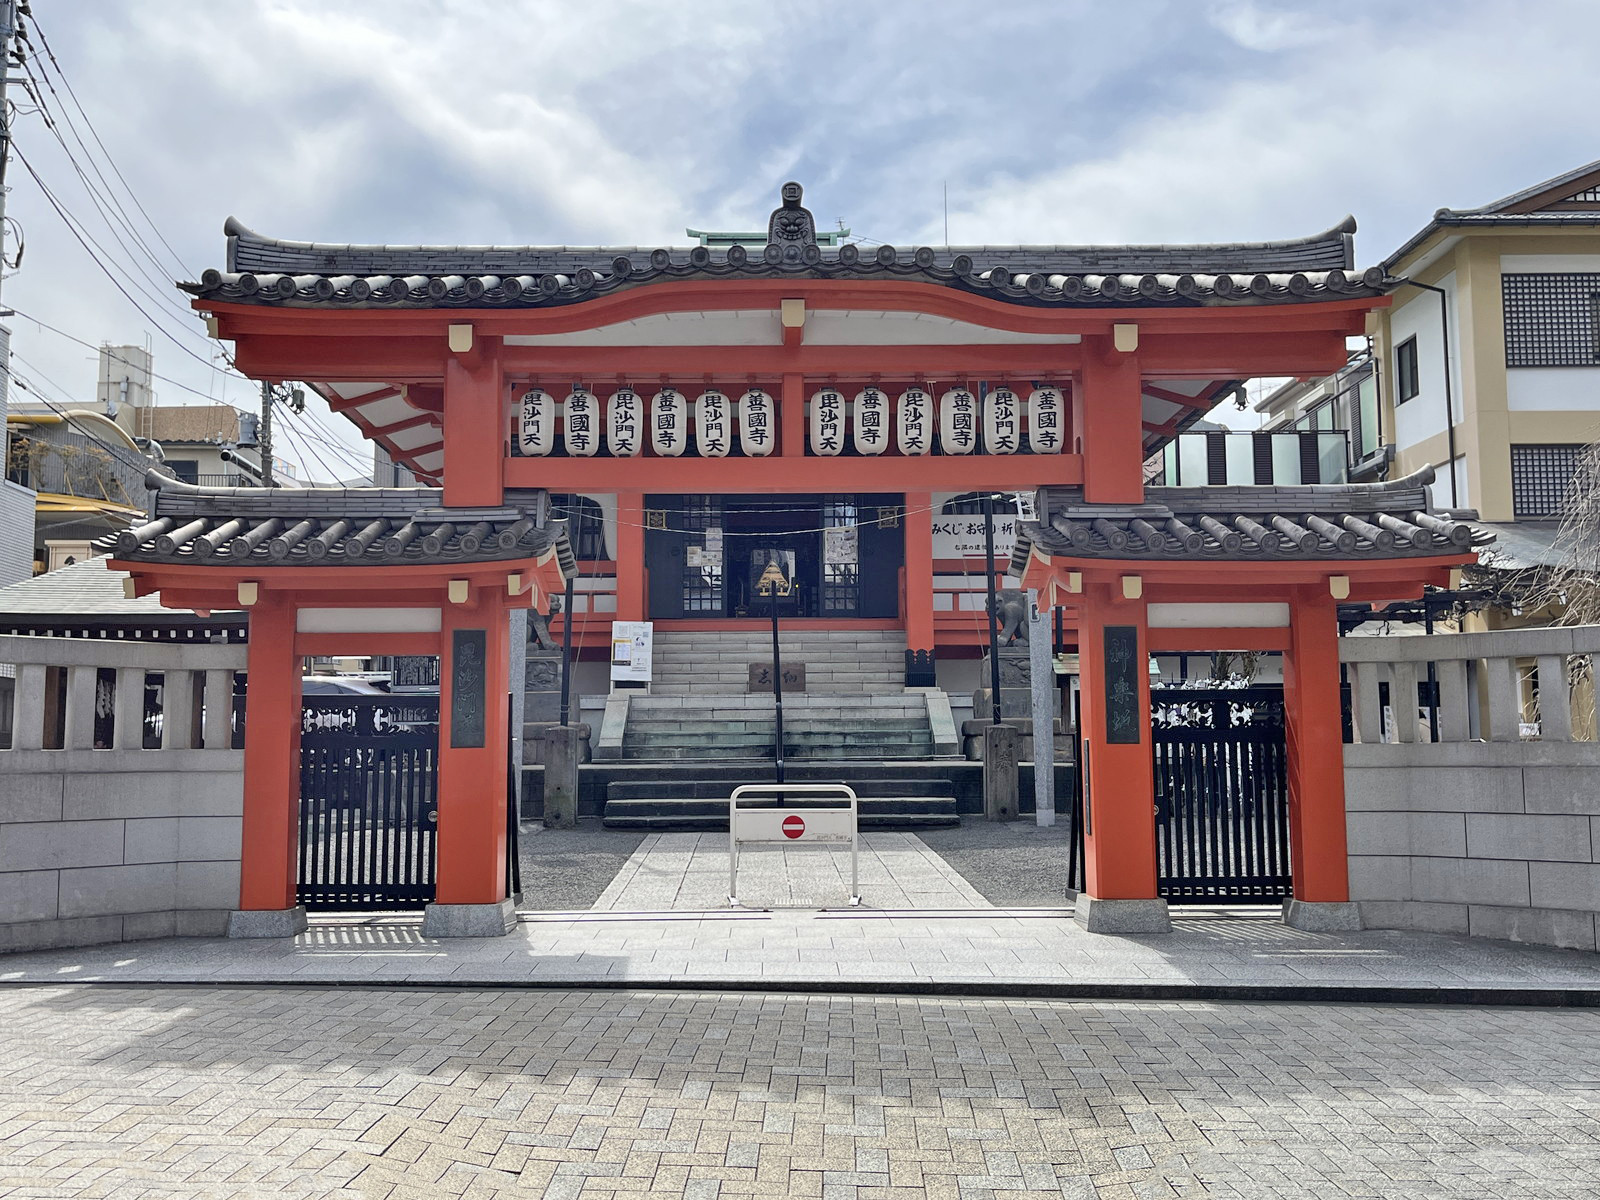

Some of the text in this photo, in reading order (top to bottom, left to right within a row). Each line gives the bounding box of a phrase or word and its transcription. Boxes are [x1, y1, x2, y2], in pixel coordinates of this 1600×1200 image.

[523, 393, 542, 446] 毘沙門天
[569, 393, 590, 450] 善國寺
[614, 393, 635, 452] 毘沙門天
[657, 392, 678, 449] 善國寺
[704, 395, 725, 453] 毘沙門天
[747, 392, 769, 446] 善國寺
[818, 393, 839, 451] 毘沙門天
[860, 391, 882, 445] 善國寺
[903, 391, 924, 449] 毘沙門天
[952, 392, 973, 447] 善國寺
[994, 391, 1015, 450] 毘沙門天
[1037, 391, 1059, 449] 善國寺
